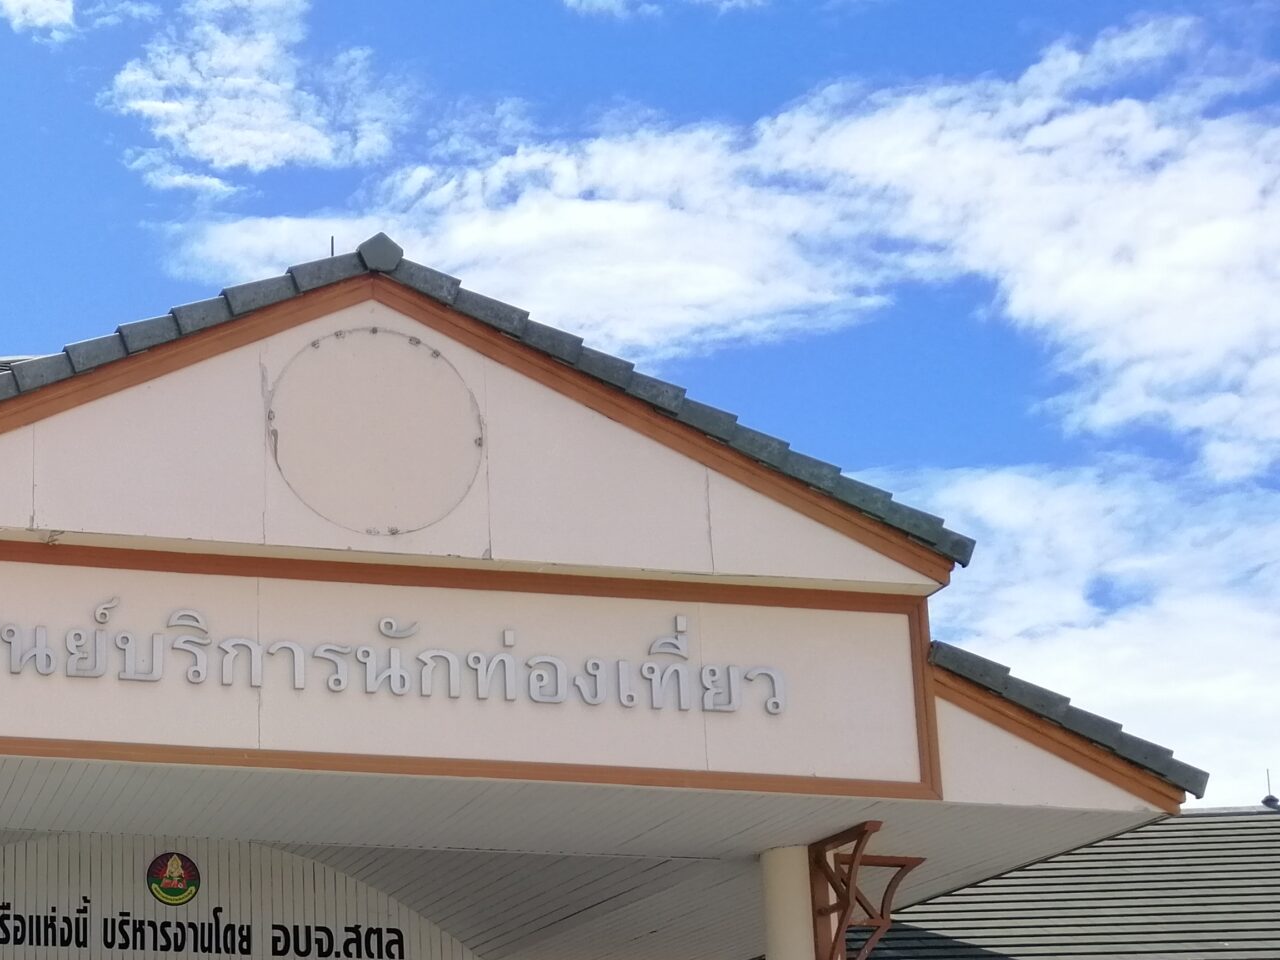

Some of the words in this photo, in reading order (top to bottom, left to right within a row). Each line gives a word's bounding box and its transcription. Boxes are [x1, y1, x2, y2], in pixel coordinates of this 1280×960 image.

[103, 907, 252, 956] บริหารงานโดย
